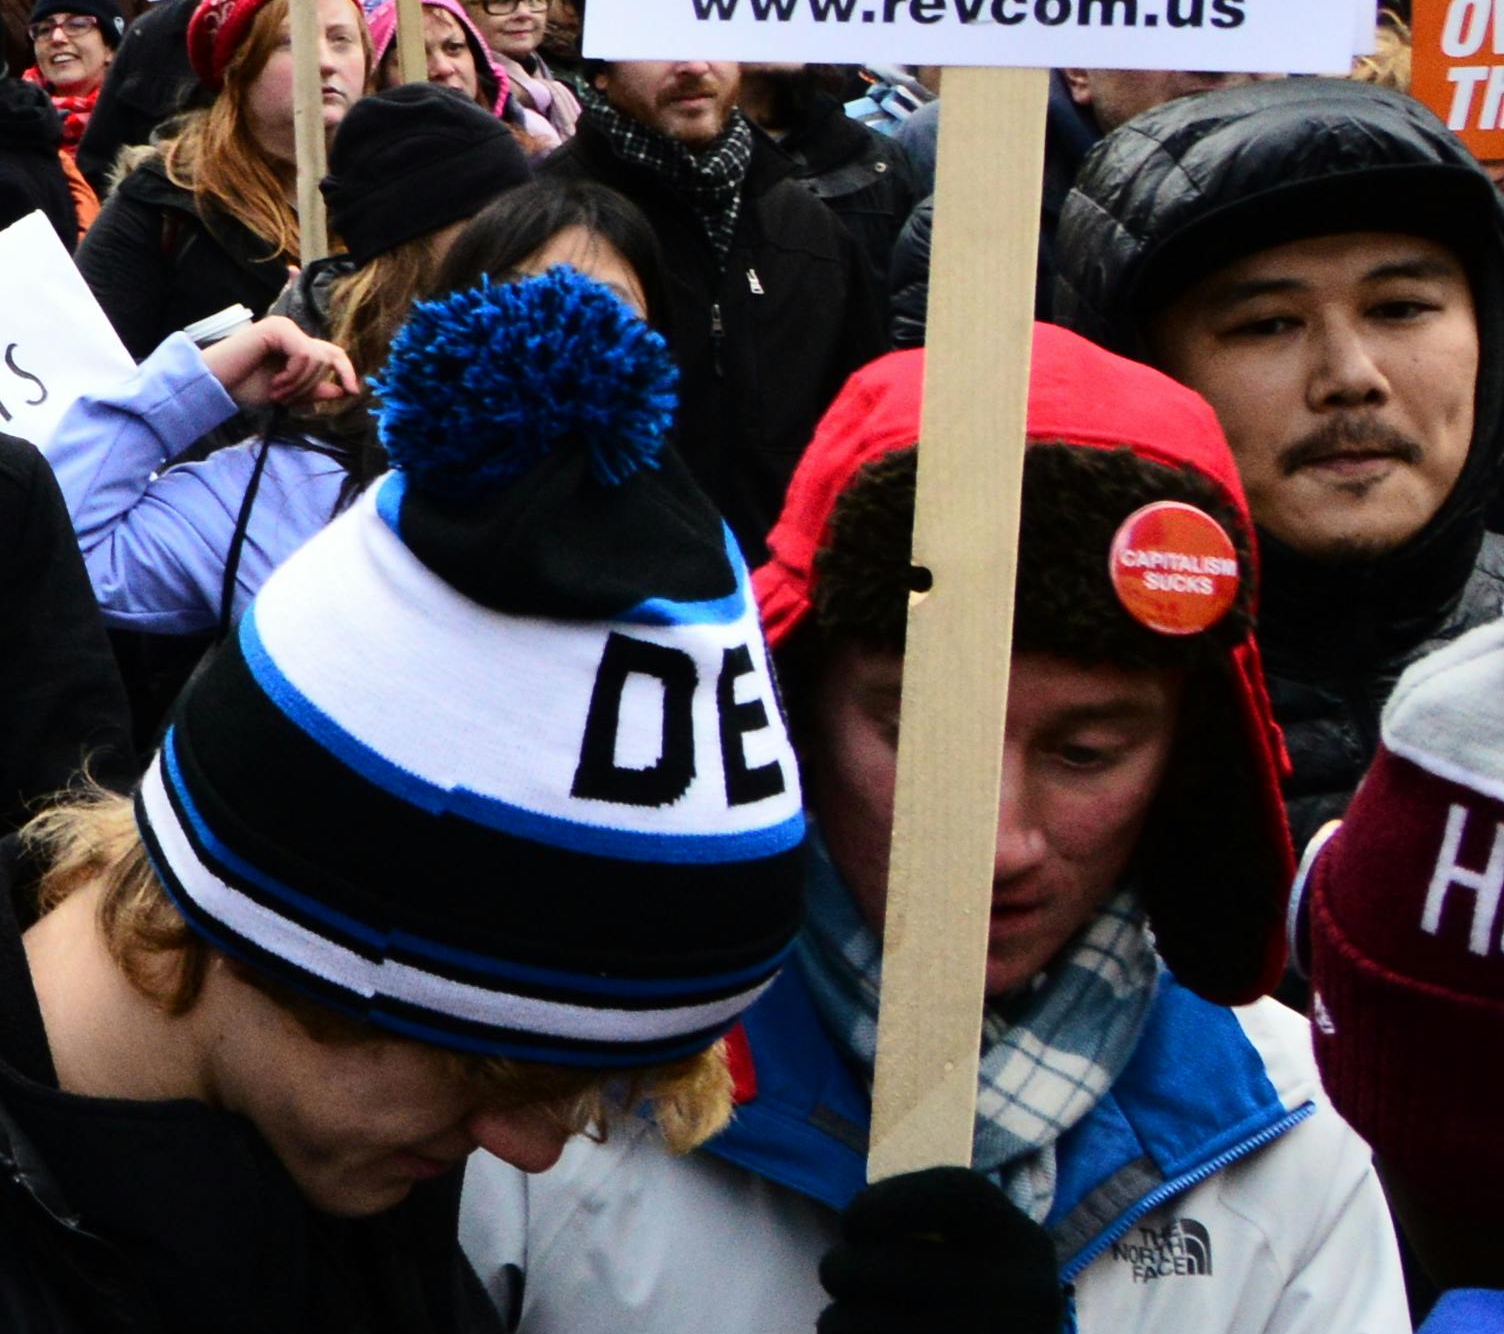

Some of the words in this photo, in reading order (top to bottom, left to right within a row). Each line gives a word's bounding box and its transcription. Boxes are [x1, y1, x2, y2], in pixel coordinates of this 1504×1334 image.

[1120, 549, 1237, 576] CAPITALISM
[1143, 571, 1213, 595] SUCKS
[1133, 1257, 1187, 1283] FACE
